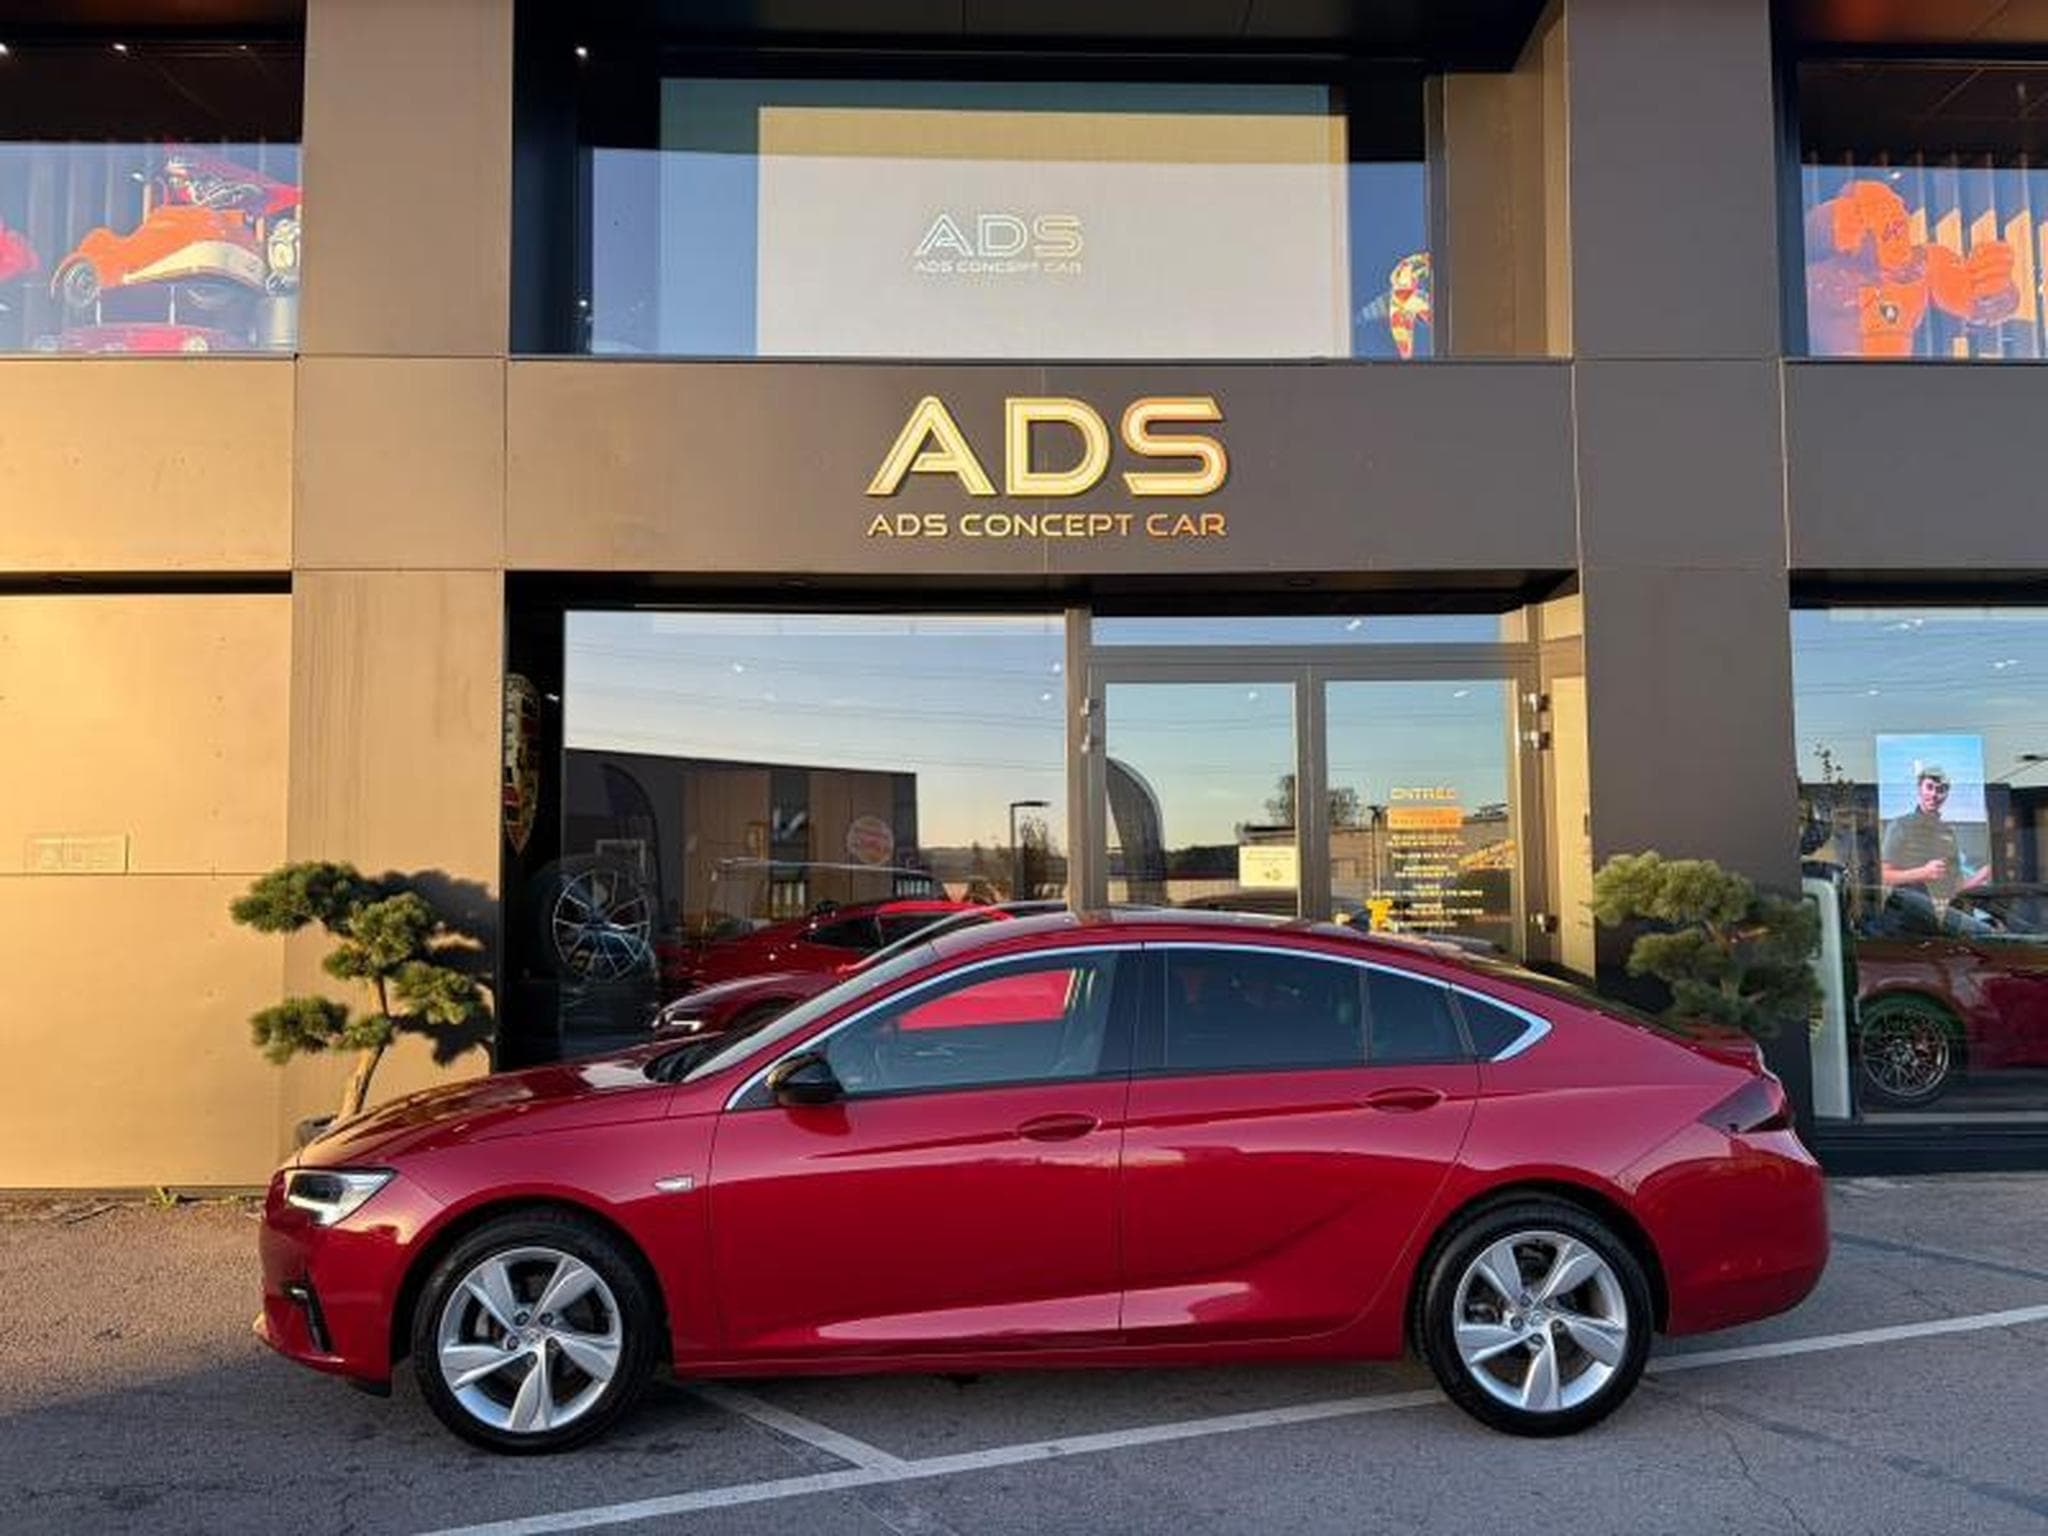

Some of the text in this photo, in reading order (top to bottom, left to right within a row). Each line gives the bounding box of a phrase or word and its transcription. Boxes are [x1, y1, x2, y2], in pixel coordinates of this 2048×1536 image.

[914, 213, 1083, 257] ADS
[914, 260, 952, 272] ADS
[865, 395, 1229, 496] ADS
[867, 513, 1227, 537] ADS CONCEPT CAR
